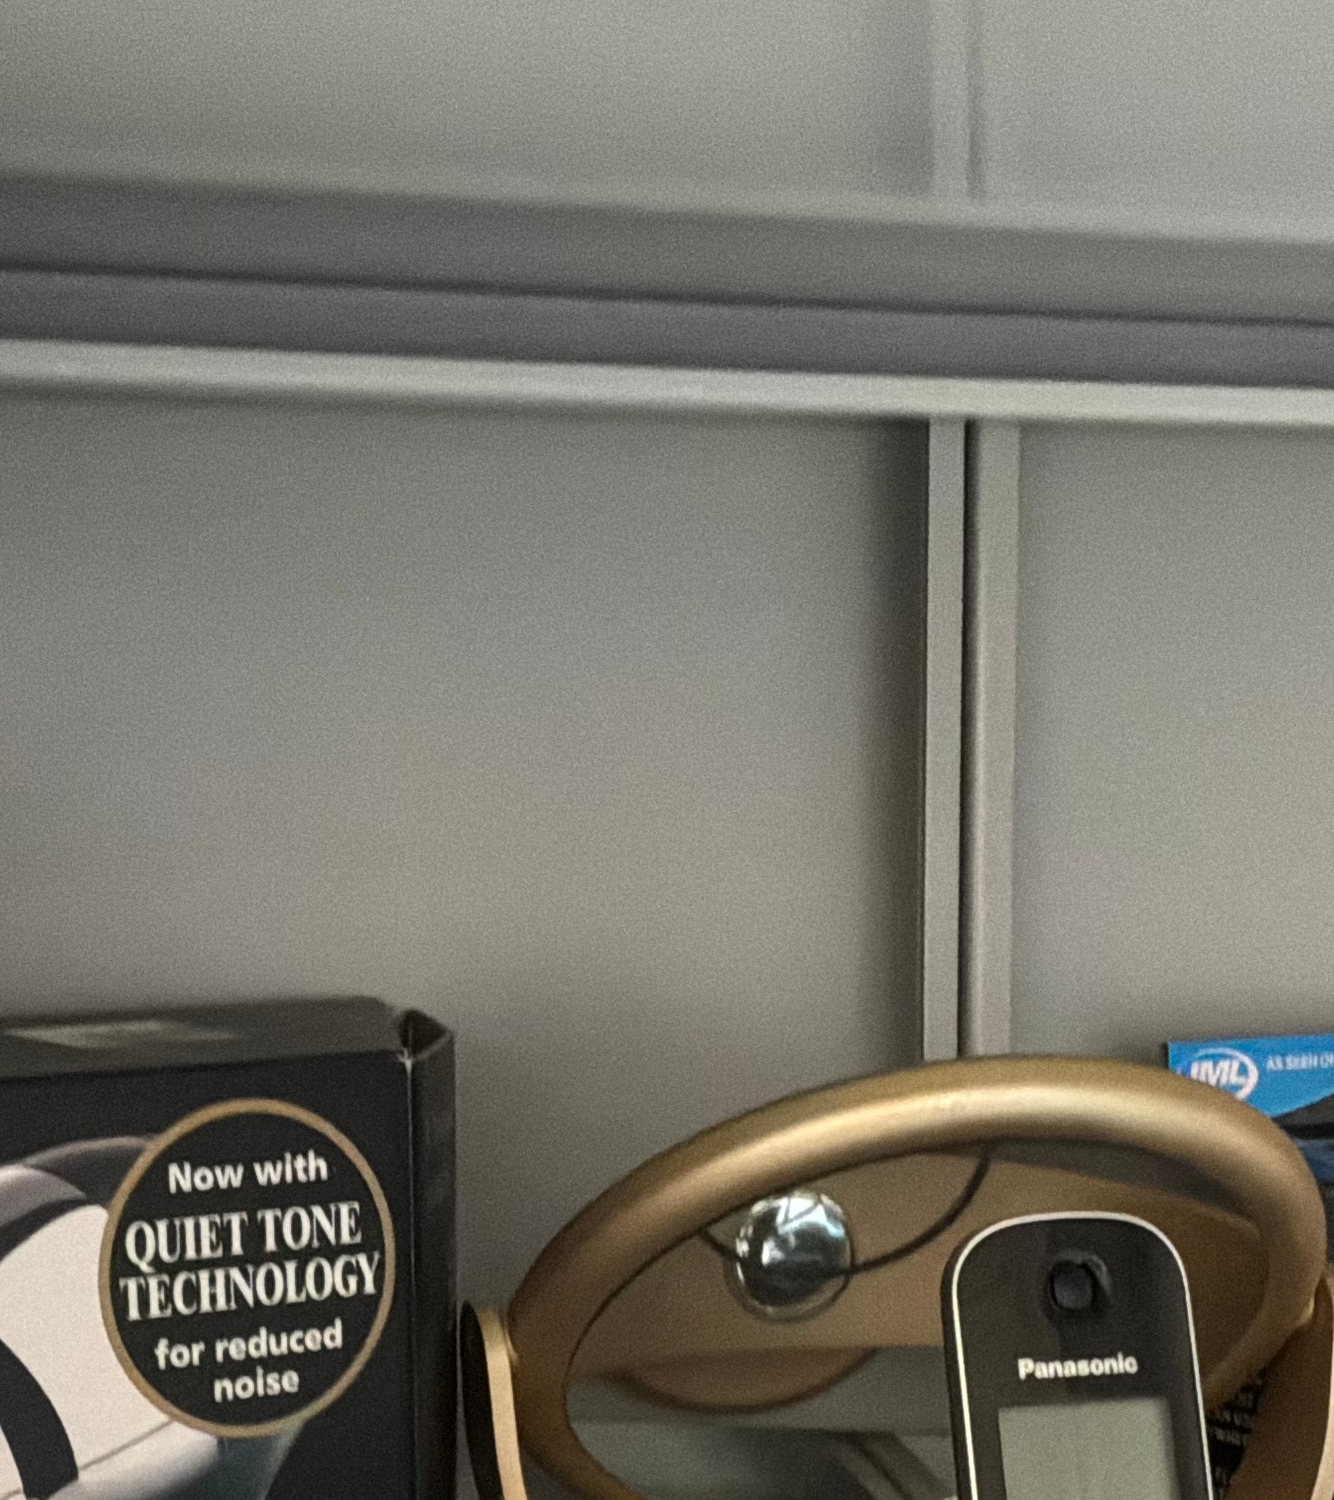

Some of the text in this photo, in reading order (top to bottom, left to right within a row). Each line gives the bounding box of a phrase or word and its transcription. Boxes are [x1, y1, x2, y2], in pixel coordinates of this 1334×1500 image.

[167, 1150, 328, 1194] Now with
[124, 1201, 362, 1272] QUIET TONE
[119, 1251, 380, 1321] TECHNOLOGY
[154, 1318, 343, 1370] for reduced
[1017, 1351, 1138, 1380] Panasonic
[214, 1366, 300, 1402] noise
